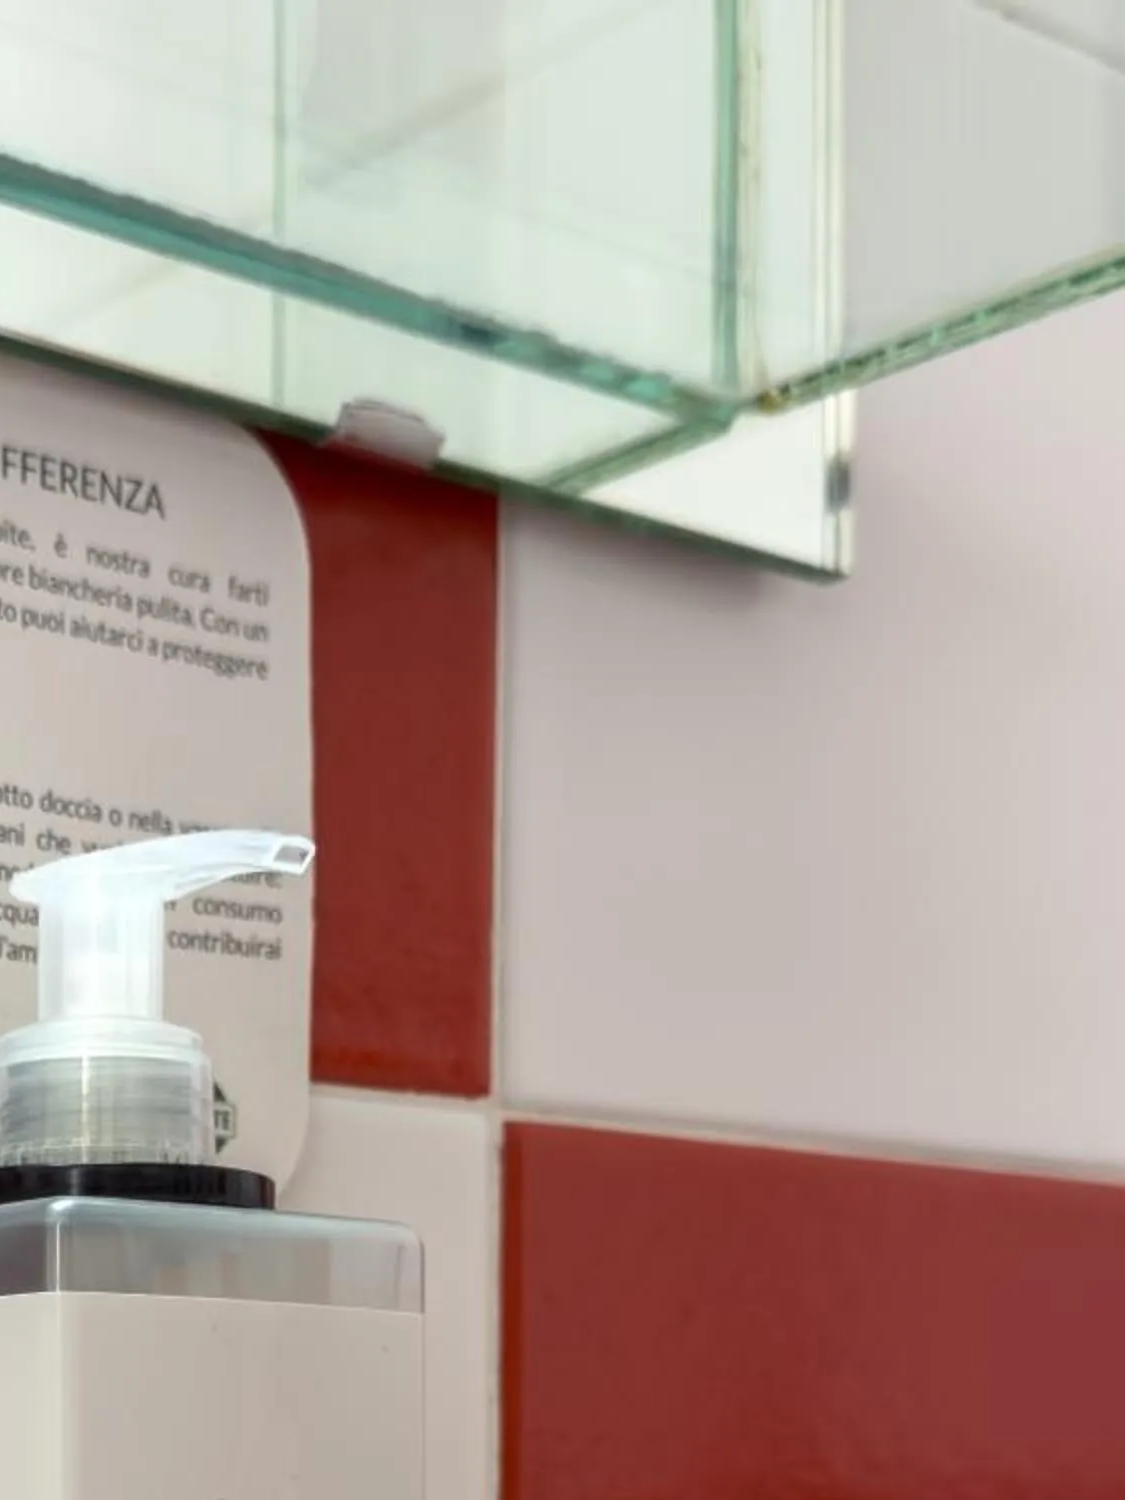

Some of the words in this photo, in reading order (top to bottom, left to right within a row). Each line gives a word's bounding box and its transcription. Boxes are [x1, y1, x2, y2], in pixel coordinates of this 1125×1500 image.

[87, 544, 150, 578] nostra
[168, 565, 211, 593] cura
[228, 576, 270, 606] farti
[29, 565, 133, 611] biancheria
[200, 608, 240, 636] Con
[243, 622, 269, 642] un
[21, 607, 65, 635] puoi
[70, 616, 143, 653] aiutarci
[147, 638, 159, 656] a
[162, 638, 269, 680] proteggere
[40, 789, 102, 824] doccia
[109, 807, 123, 828] o
[129, 808, 172, 836] nella
[36, 828, 72, 856] che
[192, 897, 283, 925] consumo
[167, 929, 283, 960] contribuirai
